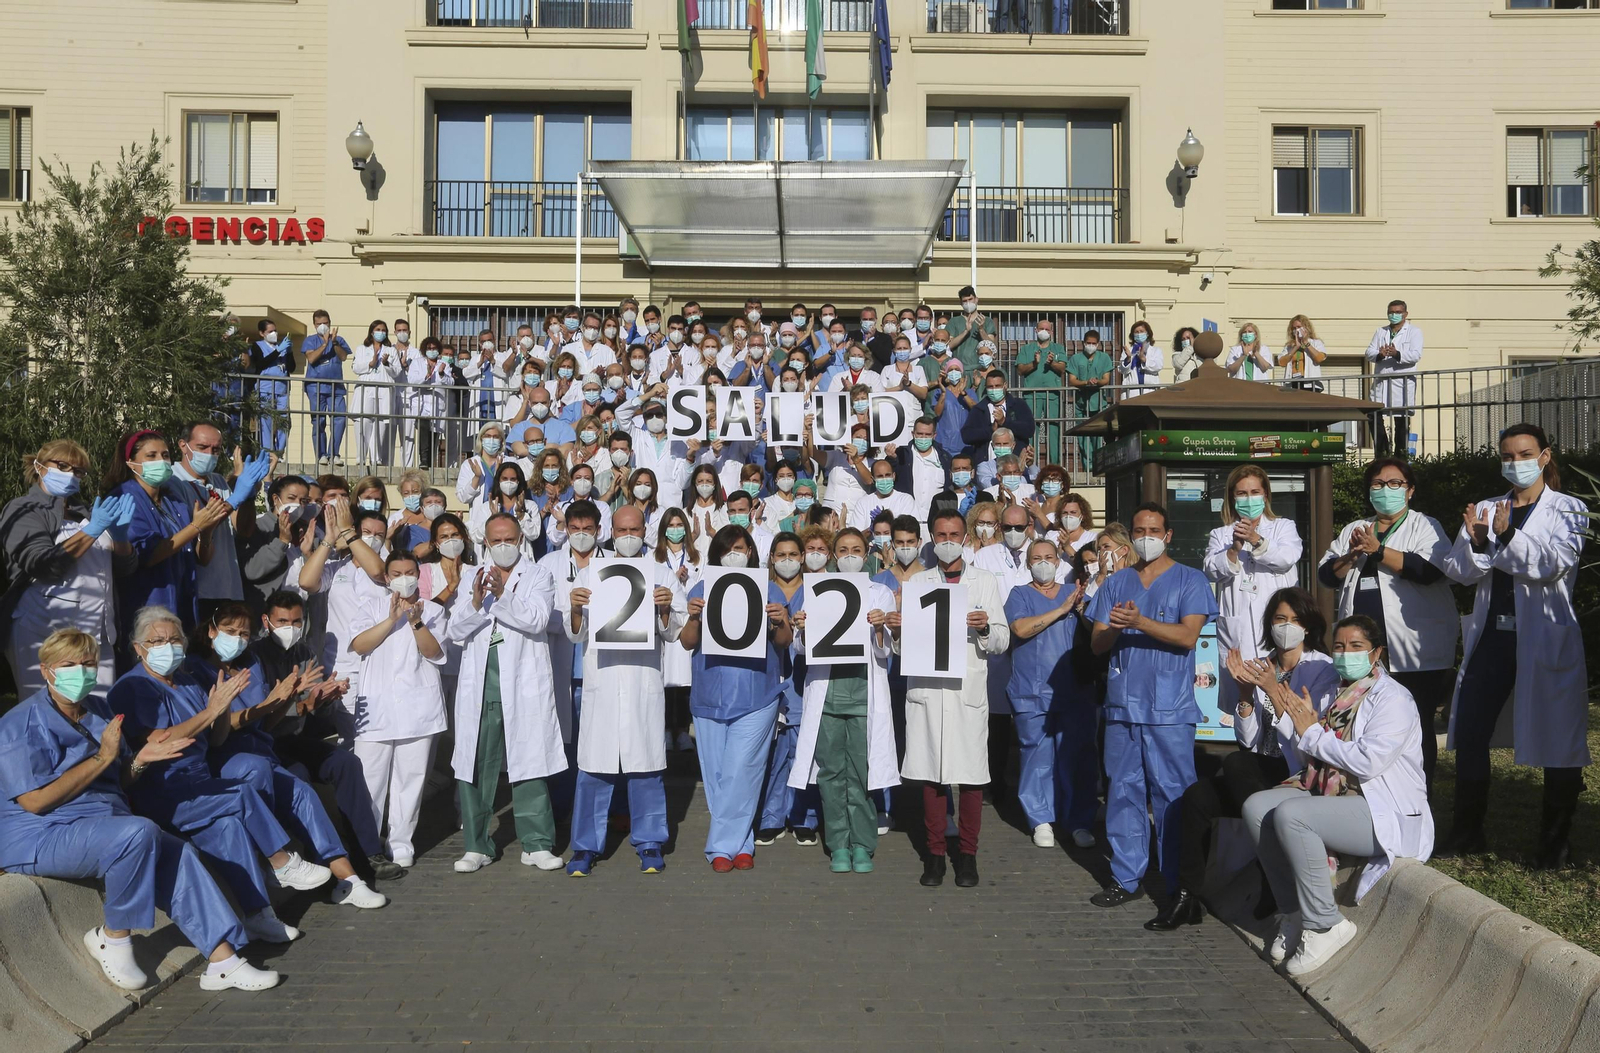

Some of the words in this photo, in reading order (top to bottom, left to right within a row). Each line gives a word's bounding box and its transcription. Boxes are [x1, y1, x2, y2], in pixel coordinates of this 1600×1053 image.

[671, 388, 905, 443] SALUD
[1182, 436, 1210, 447] Cupón
[1212, 436, 1236, 446] Extra
[1183, 446, 1194, 456] de
[595, 562, 951, 673] 2021
